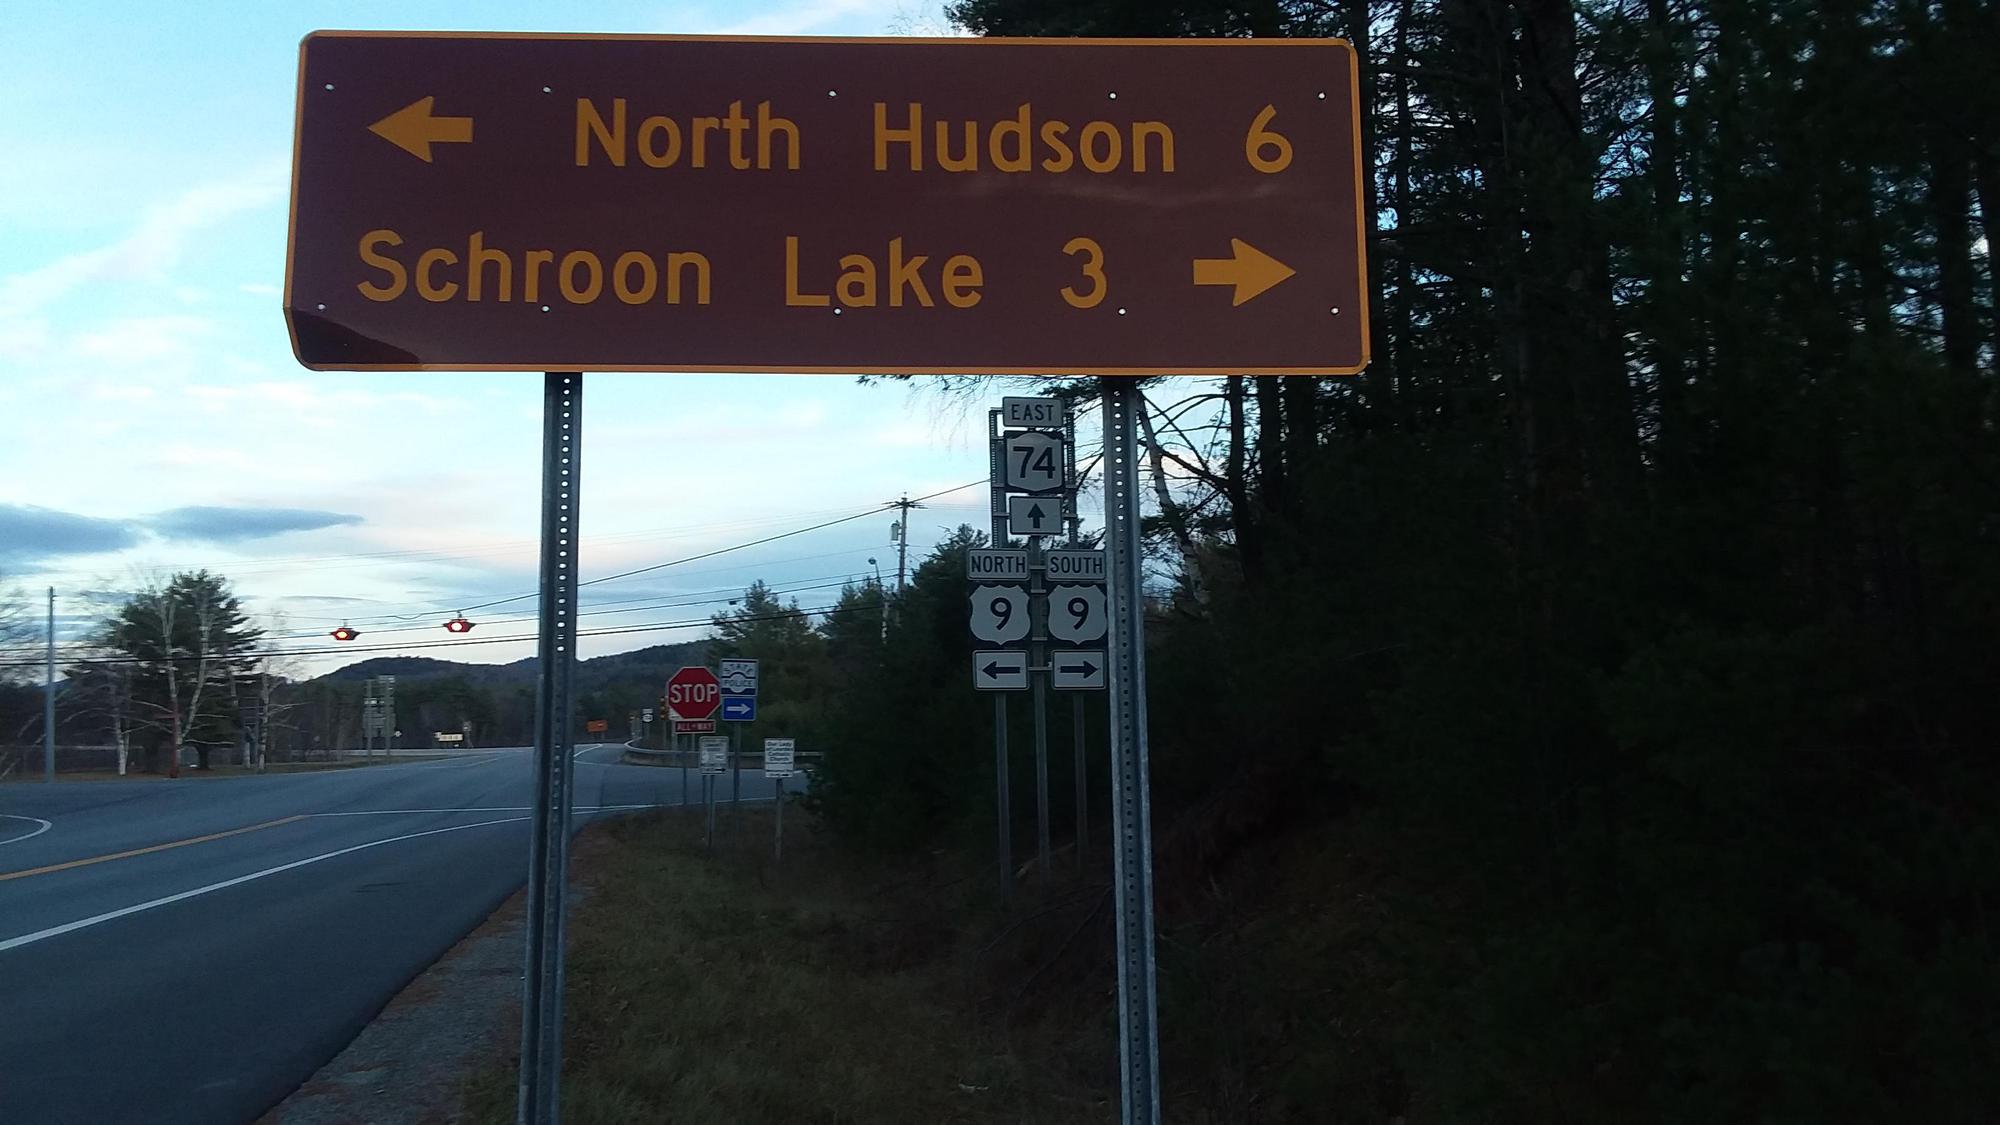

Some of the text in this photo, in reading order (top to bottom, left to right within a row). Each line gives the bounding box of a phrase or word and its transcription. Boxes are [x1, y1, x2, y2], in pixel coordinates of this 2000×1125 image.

[575, 98, 1294, 174] North Hudson 6
[357, 229, 1108, 308] Schroon Lake 3
[1011, 403, 1055, 421] EAST
[1012, 446, 1056, 480] 74
[970, 555, 1026, 574] NORTH
[1050, 556, 1103, 575] SOUTH
[990, 596, 1013, 631] 9
[1067, 596, 1090, 631] 9
[670, 683, 718, 703] STOP
[723, 679, 753, 688] POLICE
